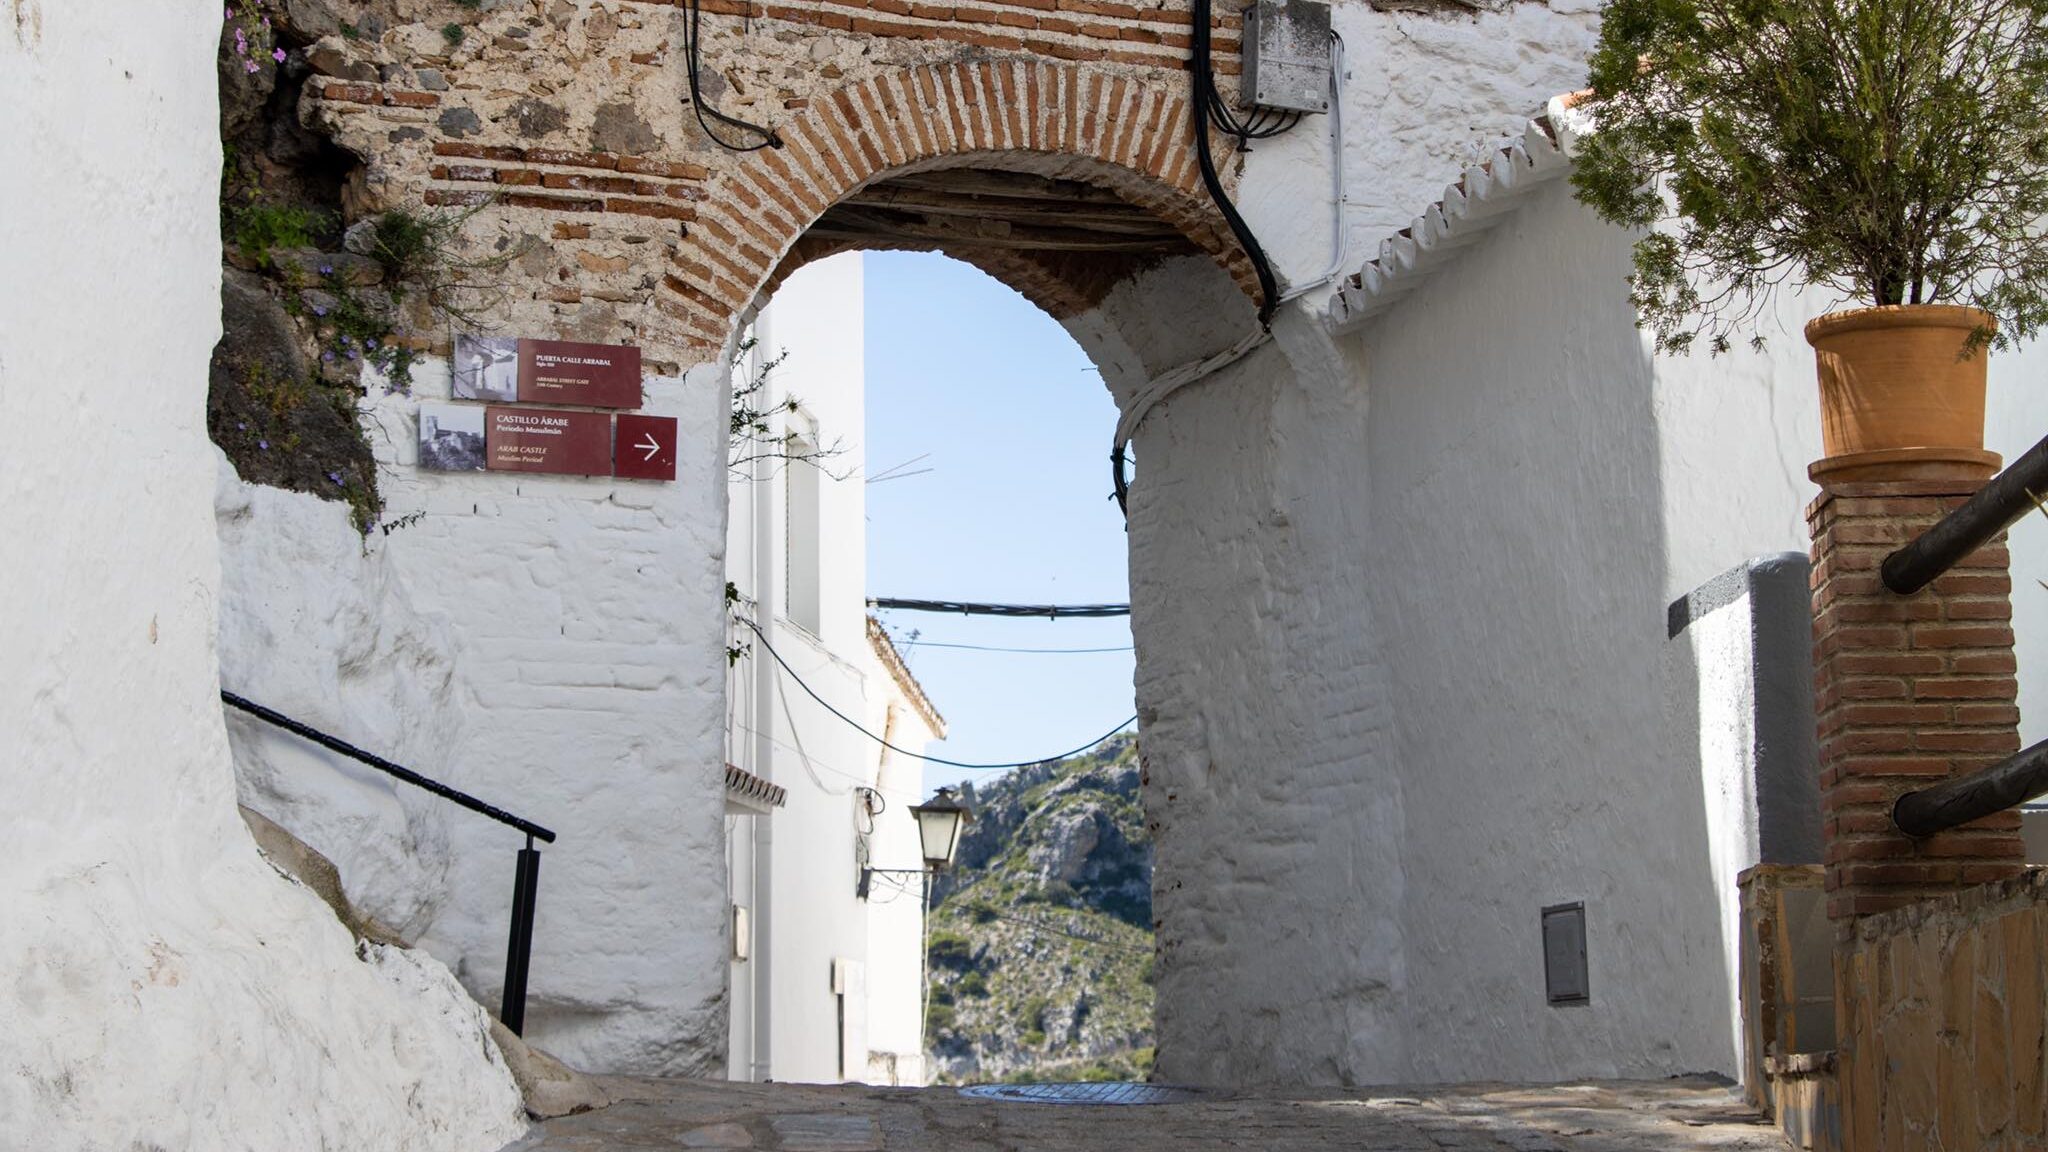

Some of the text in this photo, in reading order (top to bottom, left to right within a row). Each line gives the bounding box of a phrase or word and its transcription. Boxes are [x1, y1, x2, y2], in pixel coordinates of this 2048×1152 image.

[536, 354, 611, 366] PUERTA CALLE ARRABAL
[496, 414, 569, 426] CASTILLO ÁRABE
